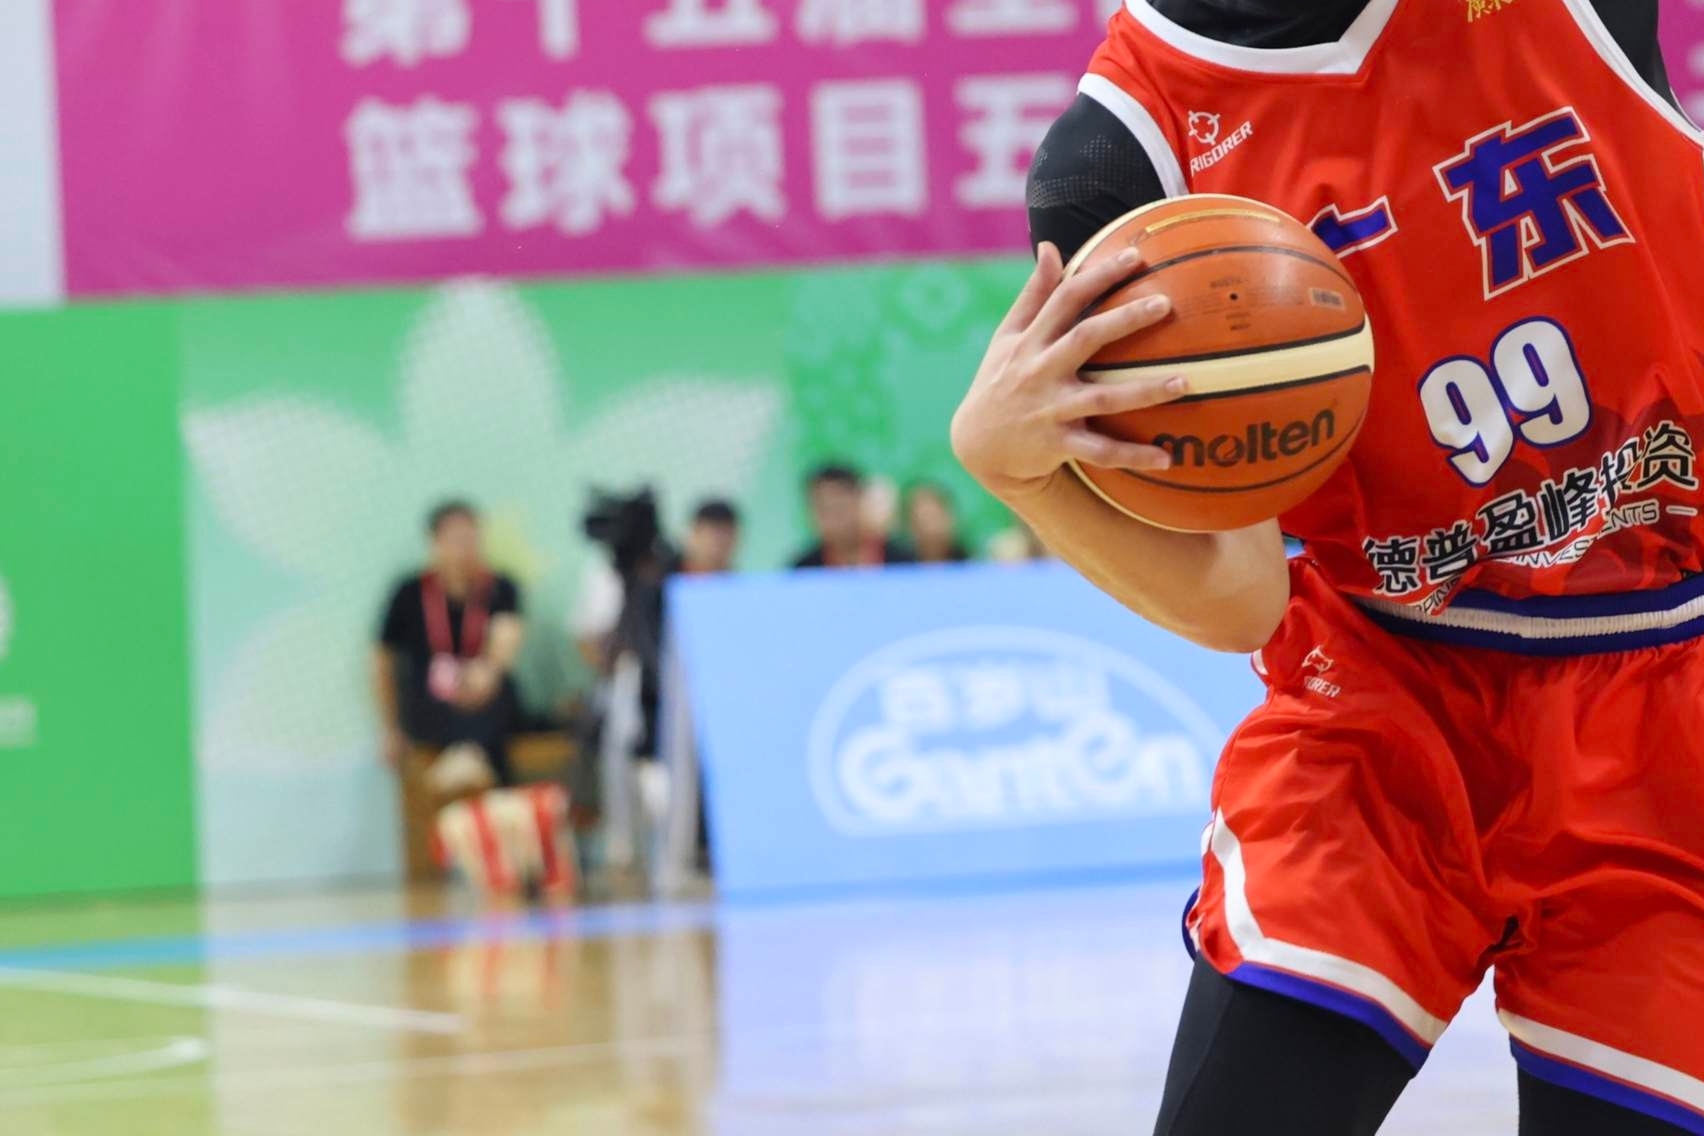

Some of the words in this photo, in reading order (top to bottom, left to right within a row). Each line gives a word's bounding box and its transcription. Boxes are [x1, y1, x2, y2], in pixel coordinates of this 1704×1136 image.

[1189, 121, 1253, 177] RIGORER
[1152, 409, 1335, 468] molten
[1417, 316, 1593, 486] 99
[1363, 421, 1697, 594] 德普盈峰投资
